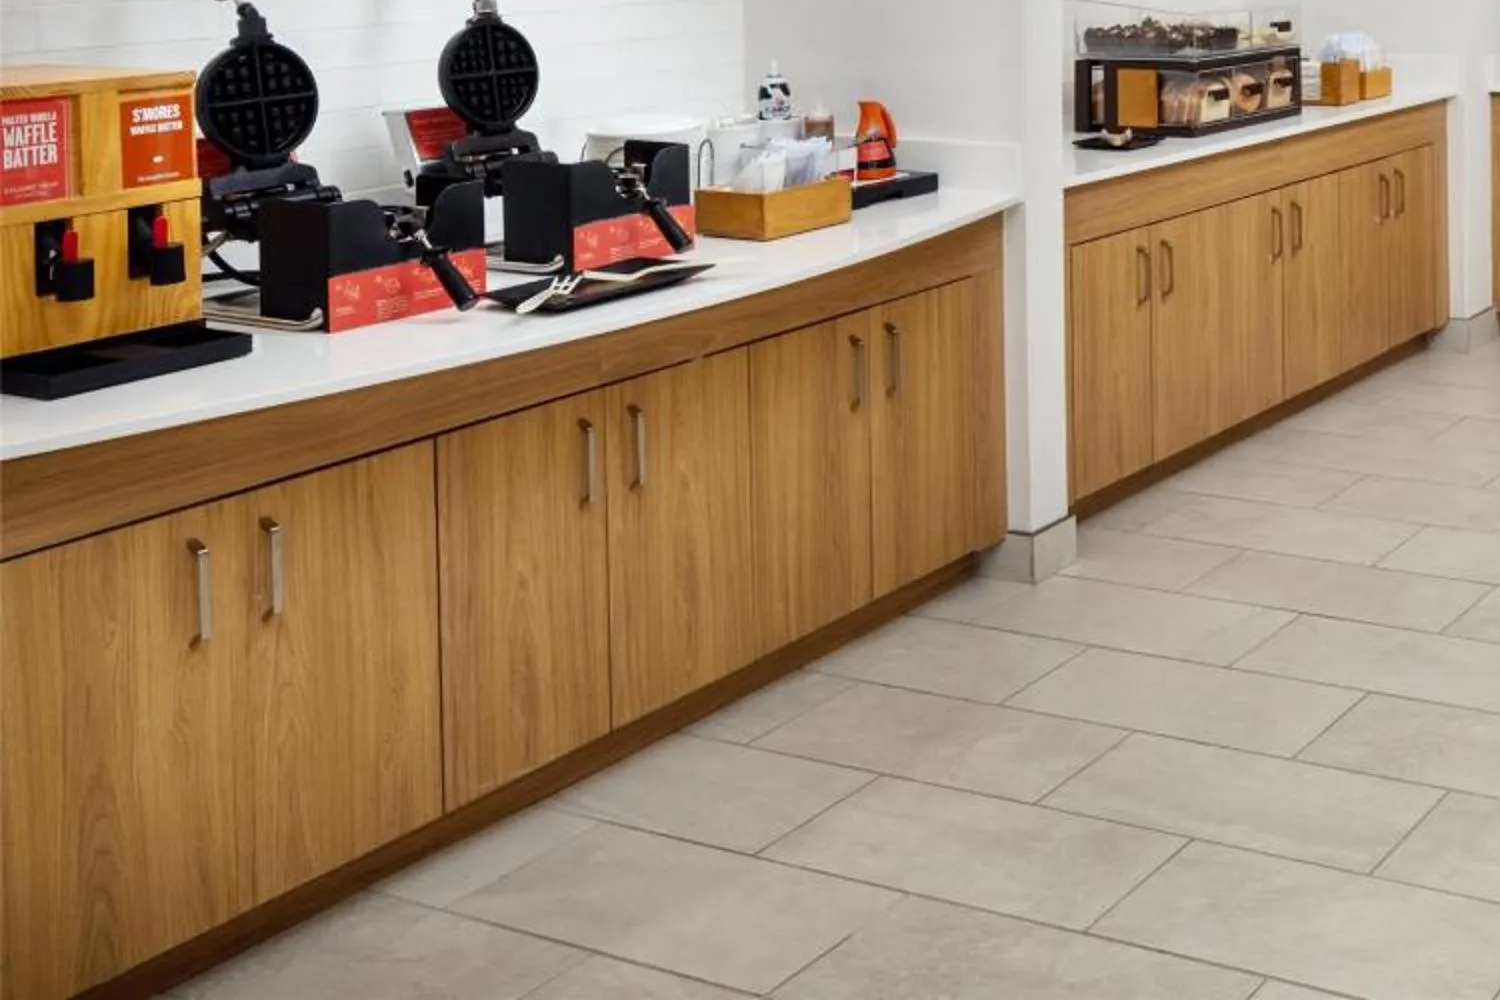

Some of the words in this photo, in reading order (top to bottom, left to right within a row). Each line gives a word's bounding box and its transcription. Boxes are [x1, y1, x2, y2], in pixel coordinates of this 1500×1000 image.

[132, 104, 181, 123] S'MORES
[3, 121, 58, 149] WAFFLE
[3, 143, 58, 169] BATTER
